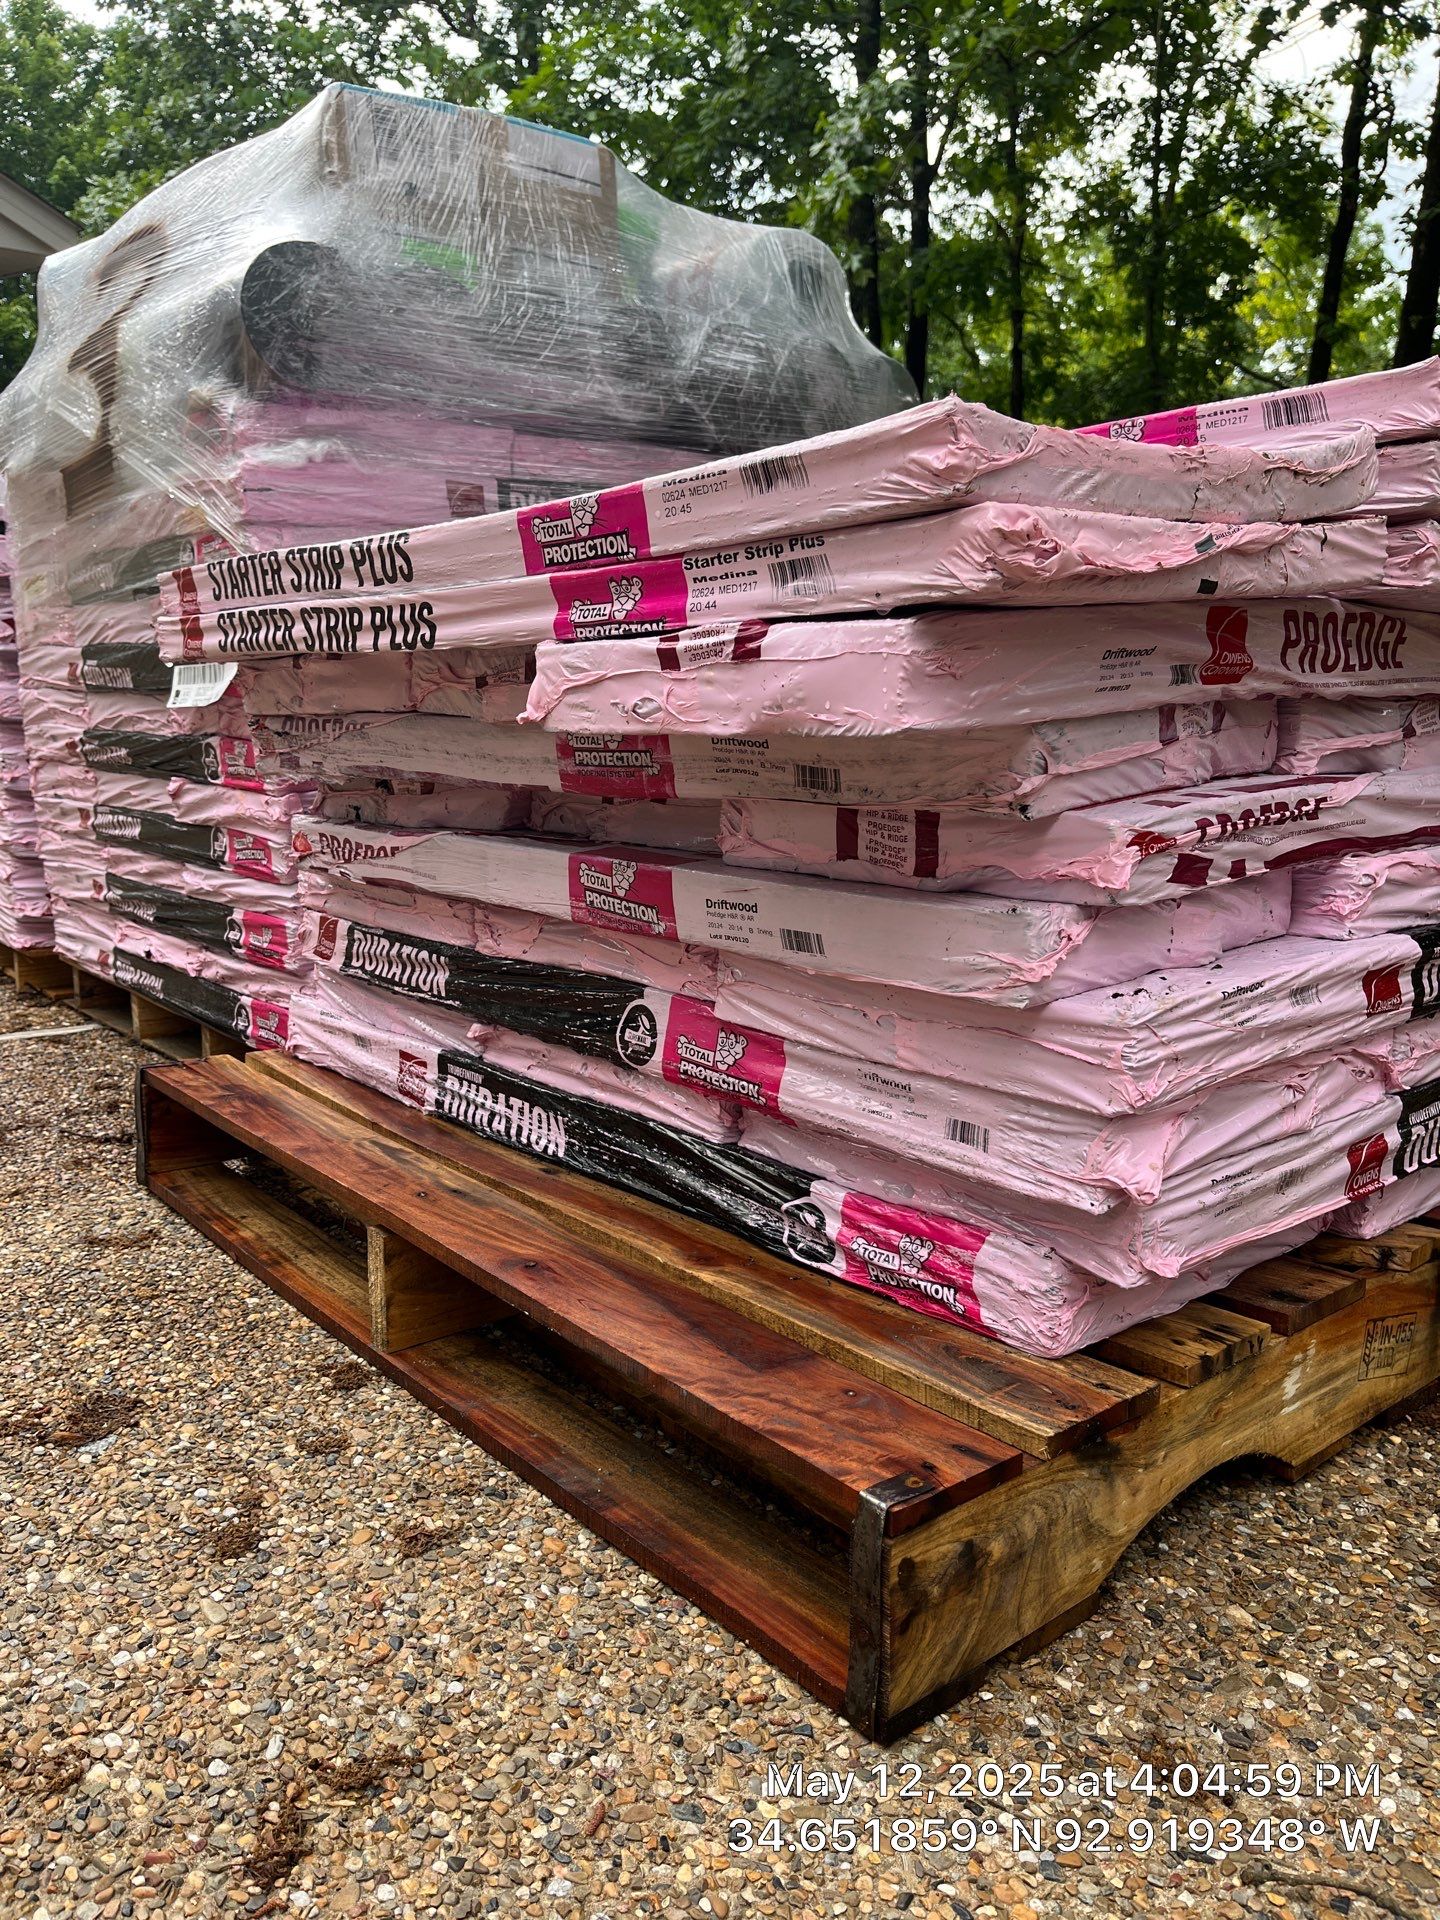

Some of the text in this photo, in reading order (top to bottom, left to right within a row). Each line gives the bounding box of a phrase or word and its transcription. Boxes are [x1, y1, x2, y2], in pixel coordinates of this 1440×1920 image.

[1178, 406, 1249, 423] Medina
[1205, 415, 1249, 430] MED1217
[662, 469, 727, 487] Medina
[662, 480, 728, 504] 02624 MED1217
[541, 521, 573, 540] TOTAL
[543, 533, 629, 565] PROTECTION
[683, 534, 826, 571] Starter Strip Plus
[206, 550, 287, 602] STARTER
[285, 544, 345, 593] STRIP
[350, 531, 415, 588] PLUS
[692, 569, 758, 584] Medina
[691, 581, 758, 599] 02624 MED1217
[577, 606, 608, 620] TOTAL
[217, 601, 438, 653] STARTER STRIP PLUS
[1280, 609, 1408, 674] PROEDGE
[1102, 645, 1158, 660] Driftwood
[574, 735, 602, 746] TOTAL
[711, 737, 769, 749] Driftwood
[574, 751, 653, 767] PROTECTION
[866, 809, 879, 817] HIP
[887, 813, 908, 823] RIDGE
[865, 828, 878, 836] HIP
[887, 834, 908, 843] RIDGE
[585, 873, 610, 889] TOTAL
[585, 890, 658, 924] PROTECTION
[705, 898, 758, 913] Driftwood
[706, 910, 727, 919] ProEdge
[351, 929, 449, 997] DURATION
[683, 1045, 712, 1063] TOTAL
[679, 1062, 760, 1098] PROTECTION
[441, 1075, 568, 1158] DURATION
[1353, 1167, 1380, 1189] OWENS
[862, 1246, 896, 1267] TOTAL
[869, 1265, 957, 1301] PROTECTION
